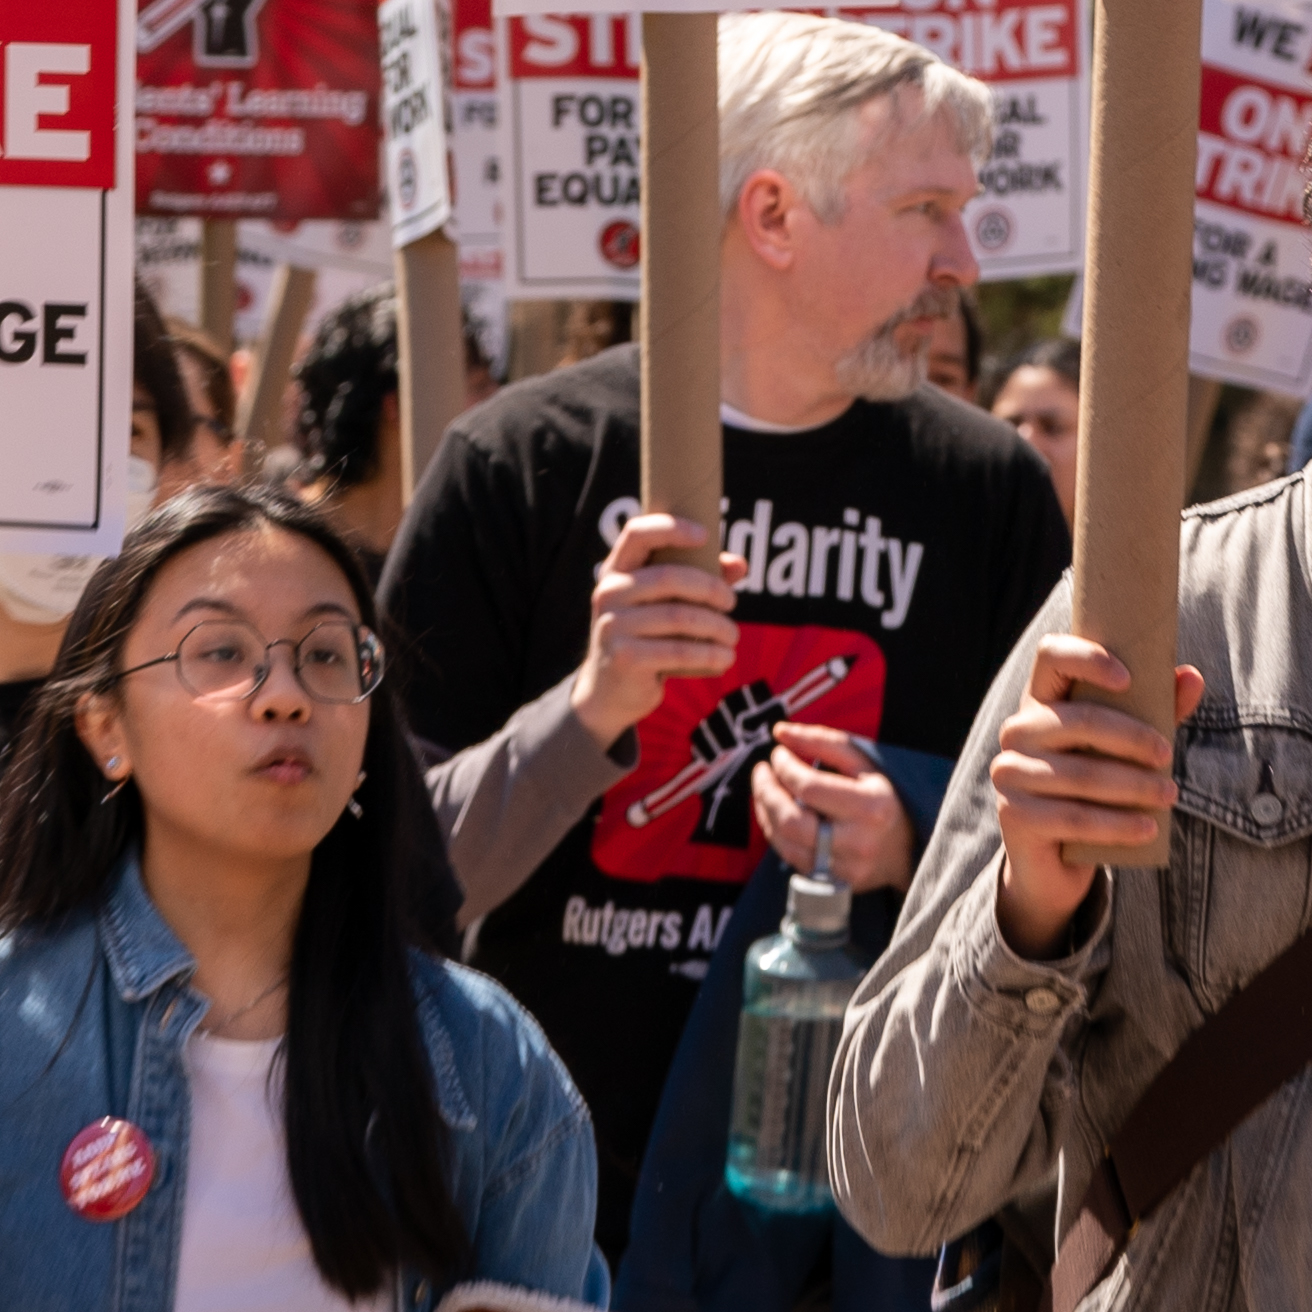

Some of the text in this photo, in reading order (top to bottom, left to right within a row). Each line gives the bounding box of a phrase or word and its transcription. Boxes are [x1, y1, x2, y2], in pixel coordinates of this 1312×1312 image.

[1233, 7, 1307, 62] WE
[552, 93, 634, 128] FOR
[585, 135, 640, 167] PA
[562, 894, 684, 956] Rutgers
